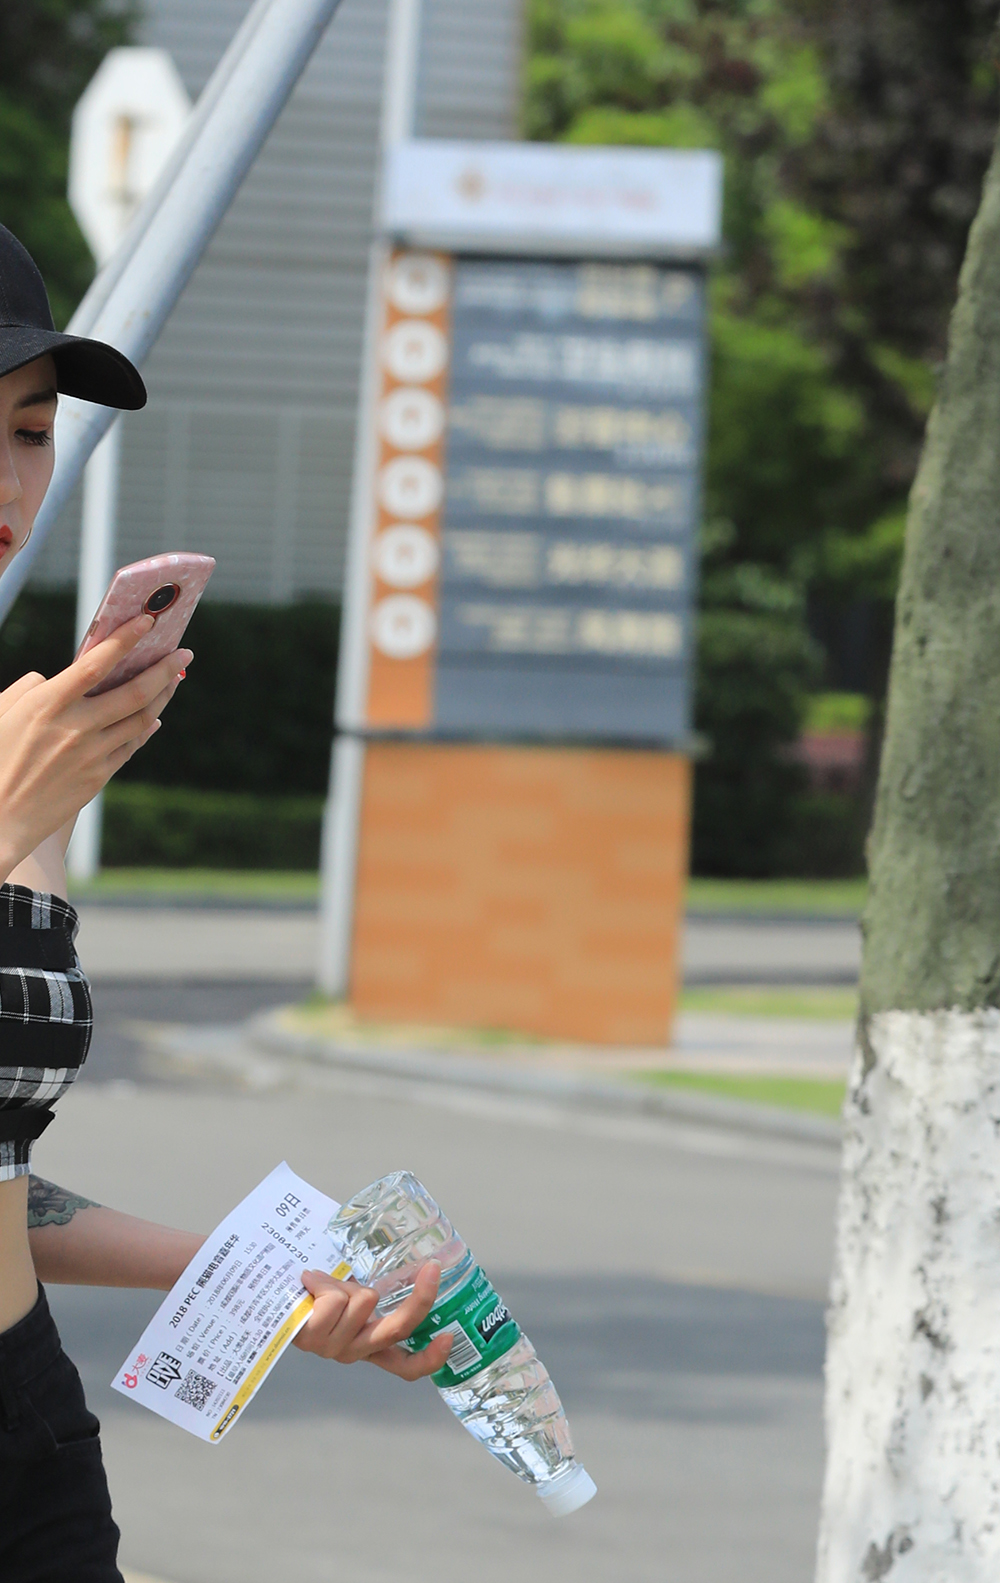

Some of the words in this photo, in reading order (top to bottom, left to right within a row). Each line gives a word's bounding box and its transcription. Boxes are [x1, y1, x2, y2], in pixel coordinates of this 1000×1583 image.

[275, 1193, 301, 1217] 09日
[262, 1222, 309, 1263] 23084230
[169, 1305, 188, 1328] 2018
[184, 1287, 200, 1306] PEC
[196, 1233, 240, 1289] 熊猫电音嘉年华
[130, 1353, 149, 1375] 大麦
[146, 1352, 171, 1383] ONE
[156, 1358, 181, 1388] LIVE
